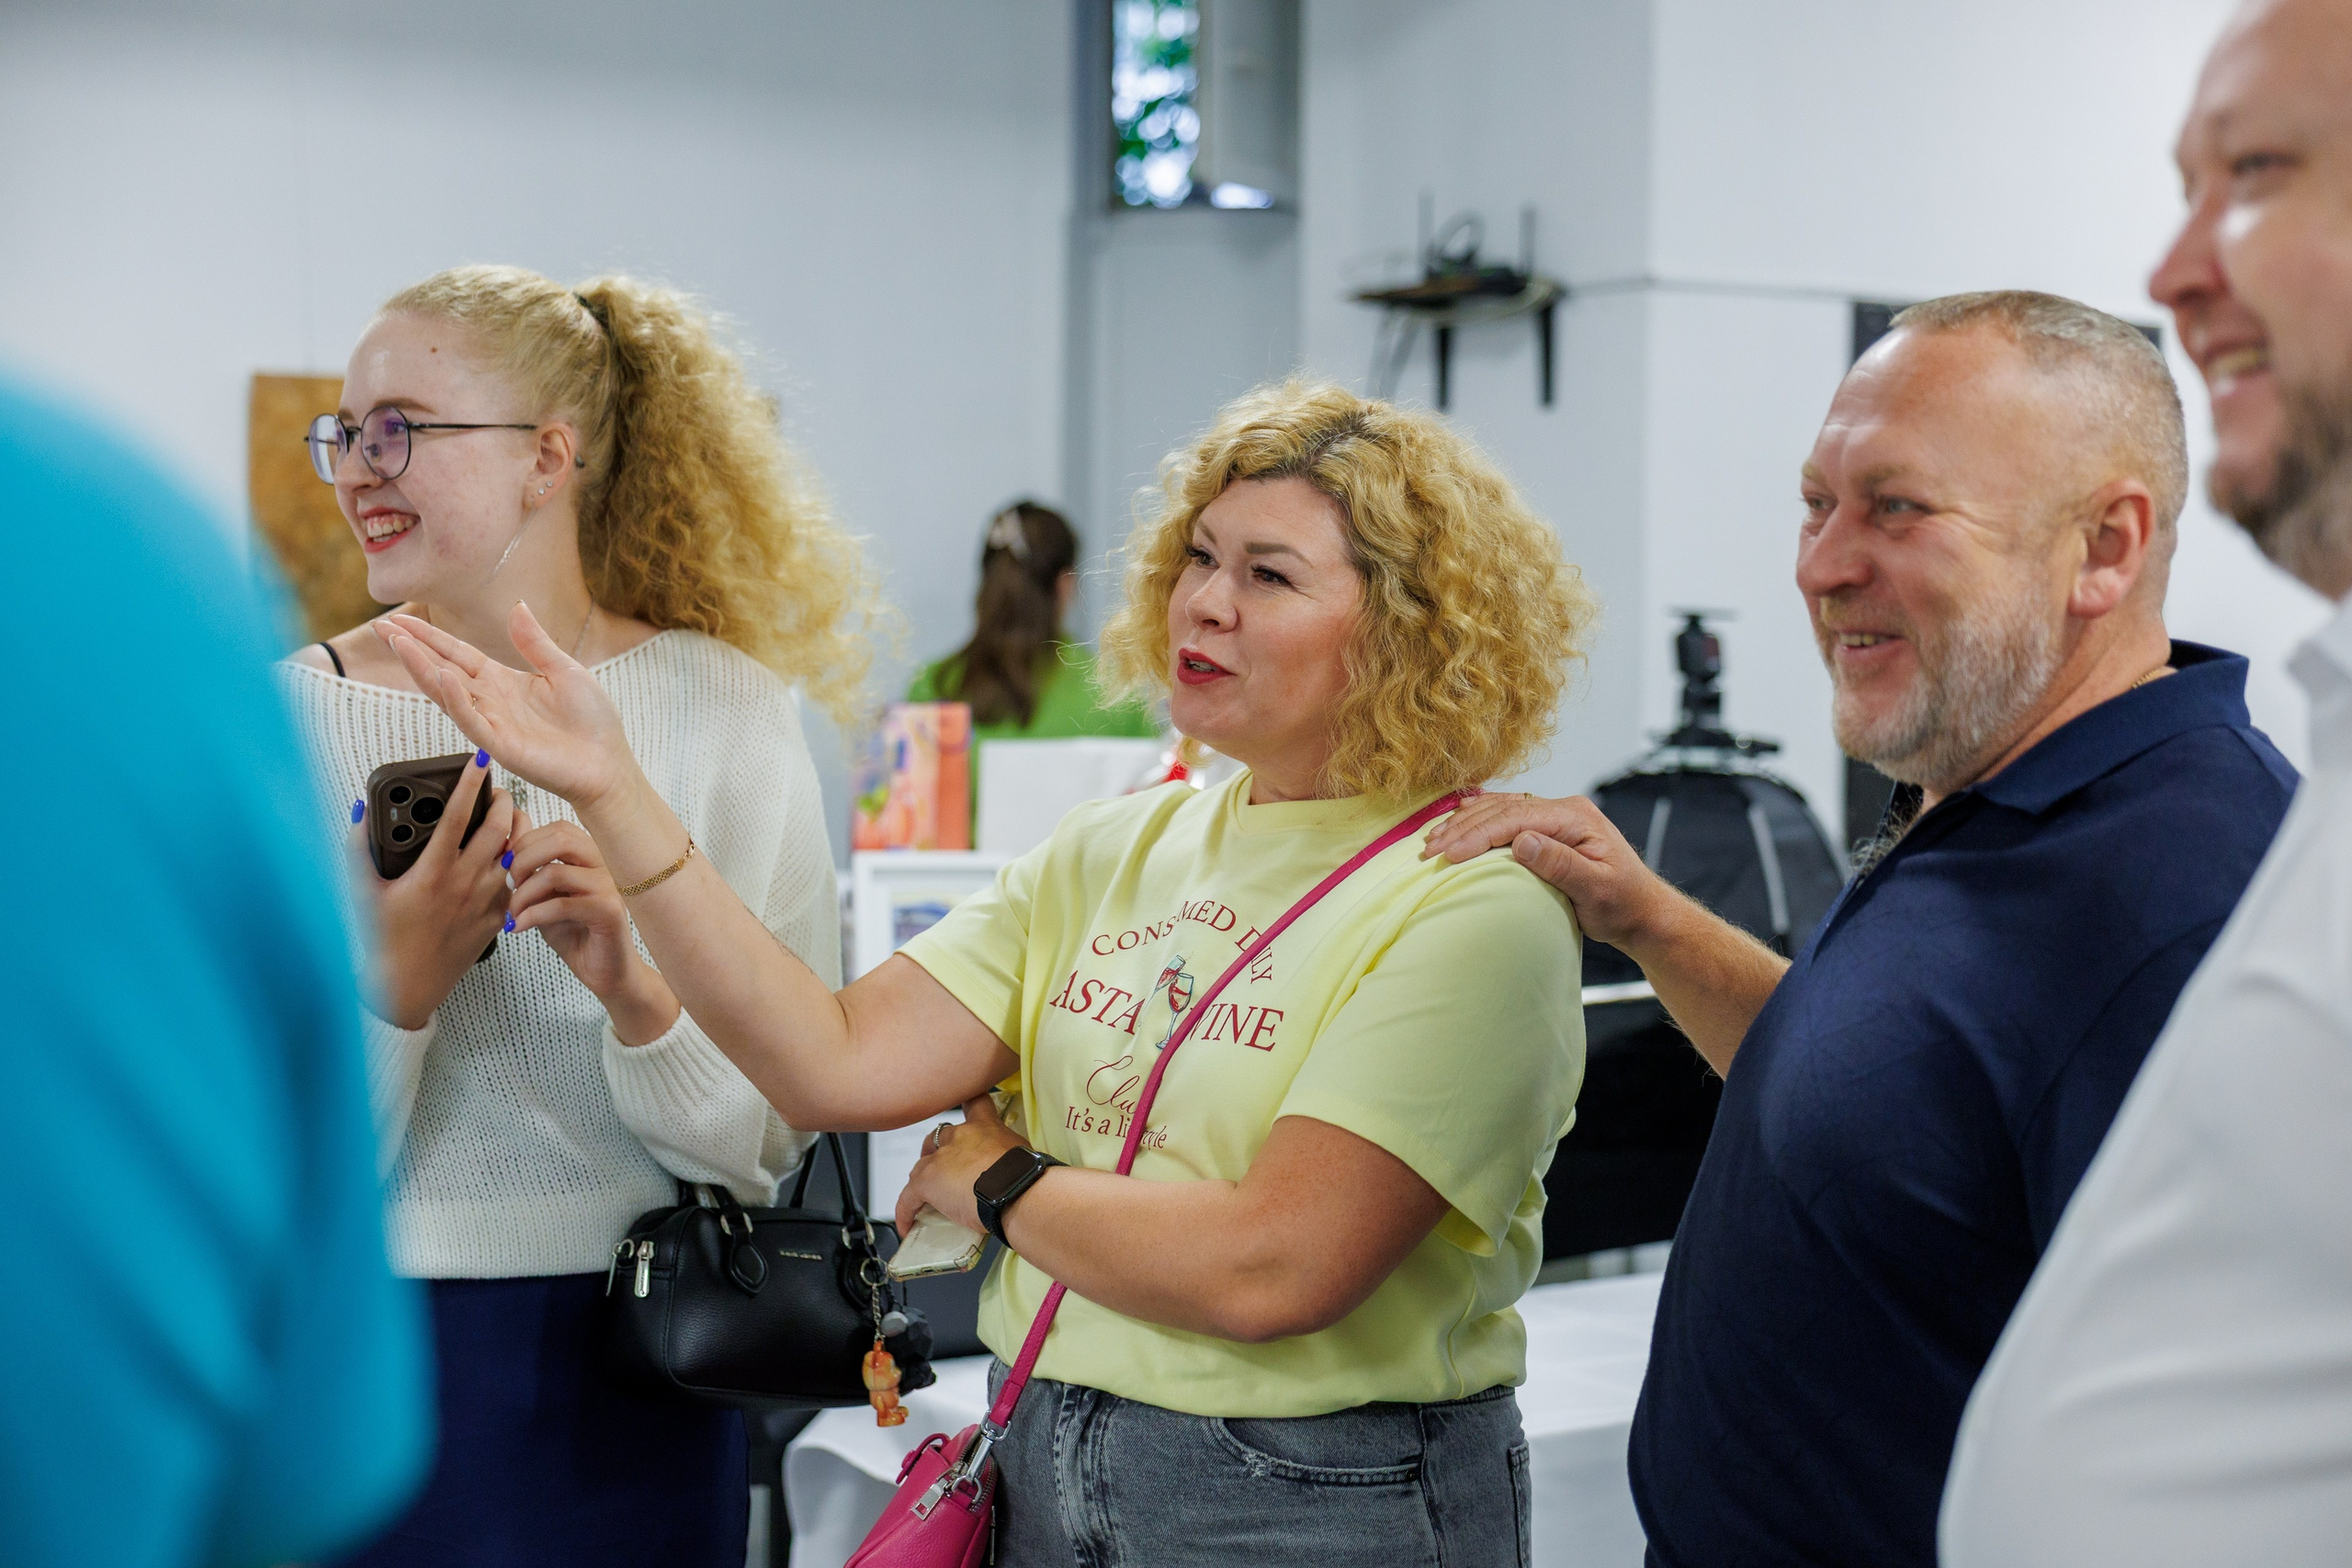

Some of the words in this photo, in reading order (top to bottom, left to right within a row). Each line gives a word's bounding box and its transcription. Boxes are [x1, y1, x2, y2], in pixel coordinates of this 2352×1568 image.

[1091, 899, 1237, 956] CONSMED
[1048, 969, 1147, 1036] ASTA
[1086, 1055, 1140, 1115] Clu
[1066, 1105, 1094, 1133] It's
[1097, 1118, 1112, 1135] a
